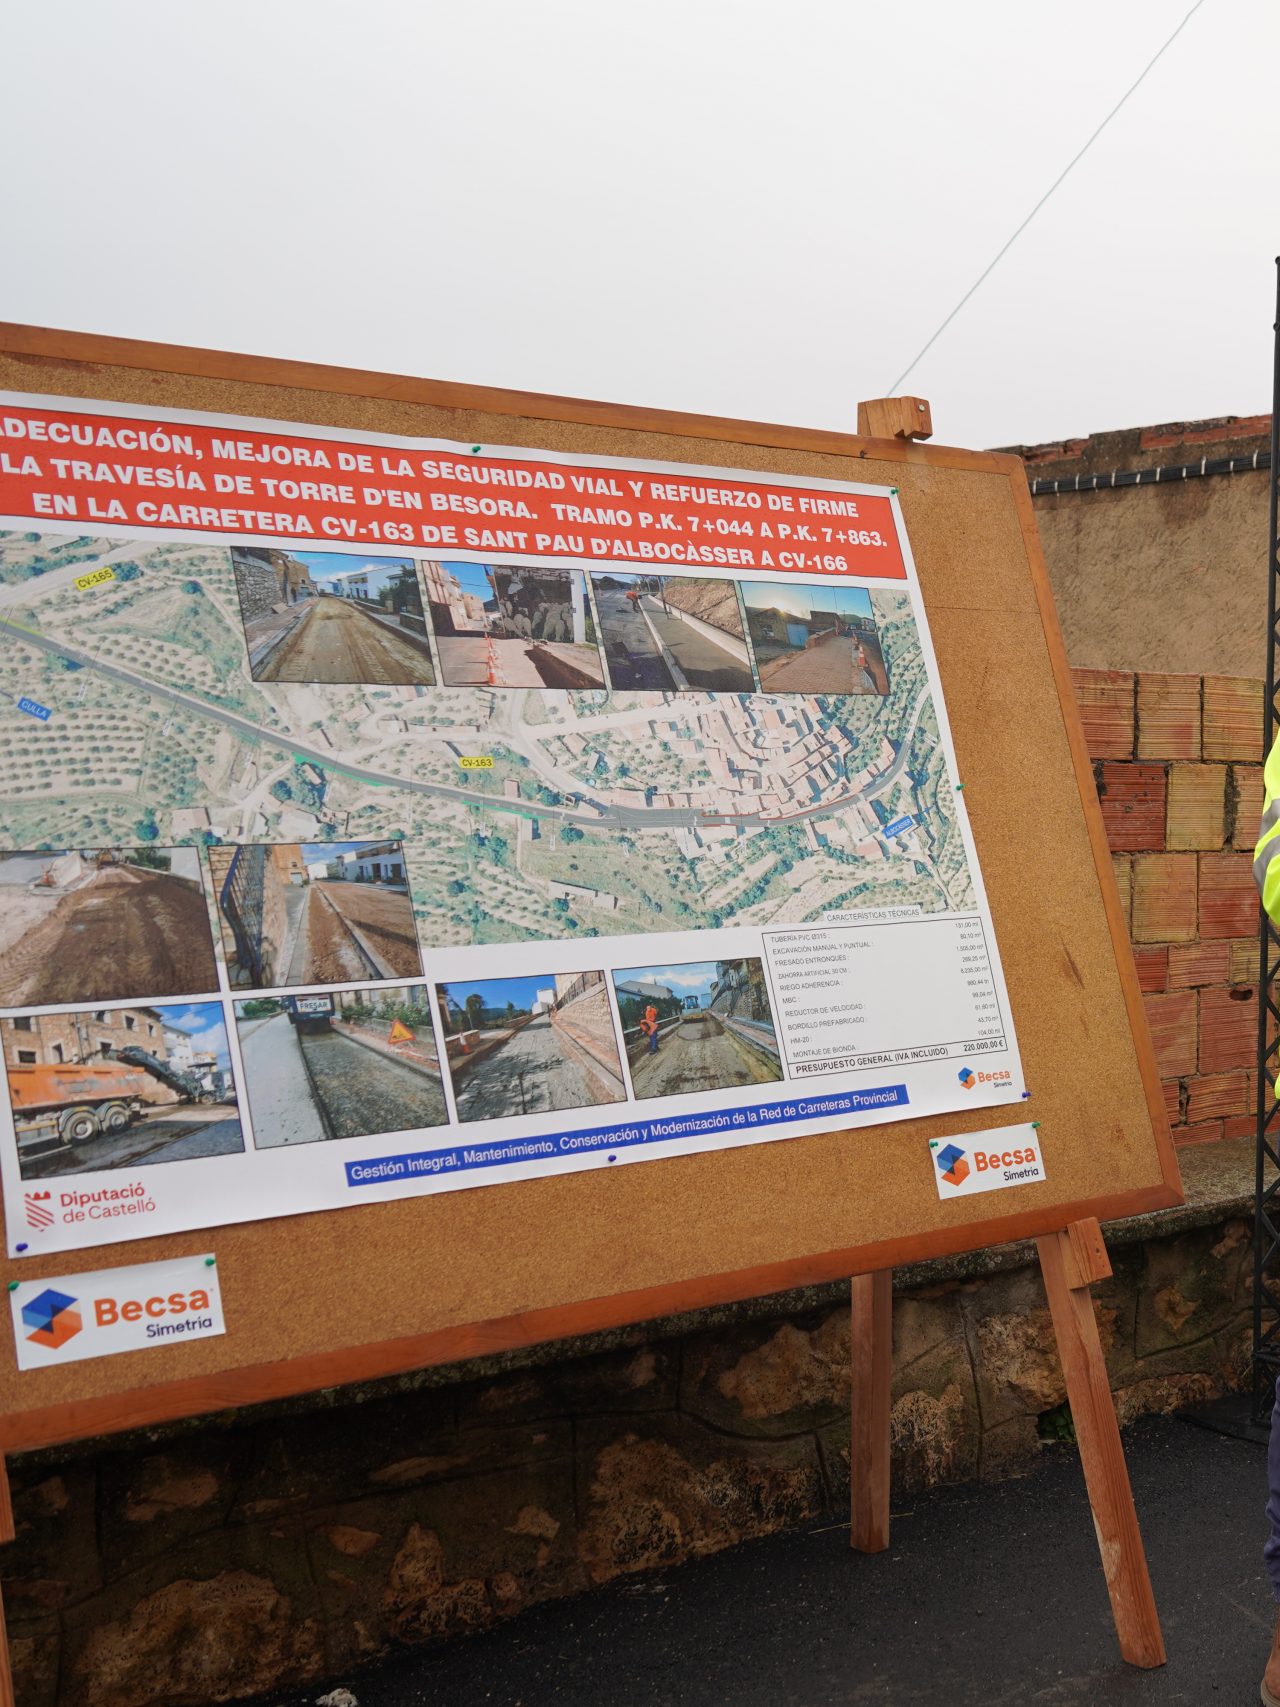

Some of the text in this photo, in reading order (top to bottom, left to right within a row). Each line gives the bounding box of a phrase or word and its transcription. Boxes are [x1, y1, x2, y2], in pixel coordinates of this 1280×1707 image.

[0, 418, 860, 518] DECUACIÓN, MEJORA DE LA SEGURIDAD VIAL Y REFUERZO DE FIRME
[0, 453, 888, 547] LA TRAVESÍA DE TORRE D'EN BESORA. TRAMO P.K. 7+044 A P.K. 7+863.
[33, 493, 848, 572] EN LA CARRETERA CV-163 DE SANT PAU D'ALBOCÀSSER A CV-166
[78, 569, 113, 588] CV-165
[21, 701, 48, 718] CULLA
[461, 758, 493, 768] CV-163
[826, 908, 920, 922] CARACTERÍSTICAS TÉCNICAS
[798, 934, 811, 942] PVC
[772, 945, 812, 955] EXCAVACIÓN
[812, 943, 838, 952] MANUAL
[844, 941, 871, 950] PUNTUAL
[775, 955, 847, 966] FRESADO ENTRONQUES
[778, 971, 803, 979] ZAHORRA
[779, 980, 840, 991] RIEGO ADHERENCIA
[782, 996, 797, 1004] MBC
[785, 1003, 863, 1017] REDUCTOR DE VELOCIDAD
[787, 1016, 865, 1031] BORDILLO PREFABRICADO
[790, 1036, 810, 1045] HM-20
[998, 1039, 1004, 1047] €
[793, 1044, 856, 1058] MONTAJE DE BIONDA
[795, 1047, 949, 1074] PRESUPUESTO GENERAL (IVA INCLUIDO)
[977, 1070, 1011, 1083] Becsa
[352, 1090, 898, 1180] Gestión Integral, Mantenimiento, Conservación y Modernización de la Red de Carreteras Provincial
[973, 1147, 1037, 1172] Becsa
[60, 1182, 145, 1207] Diputació
[63, 1197, 156, 1223] de Castelló
[94, 1289, 210, 1328] Becsa
